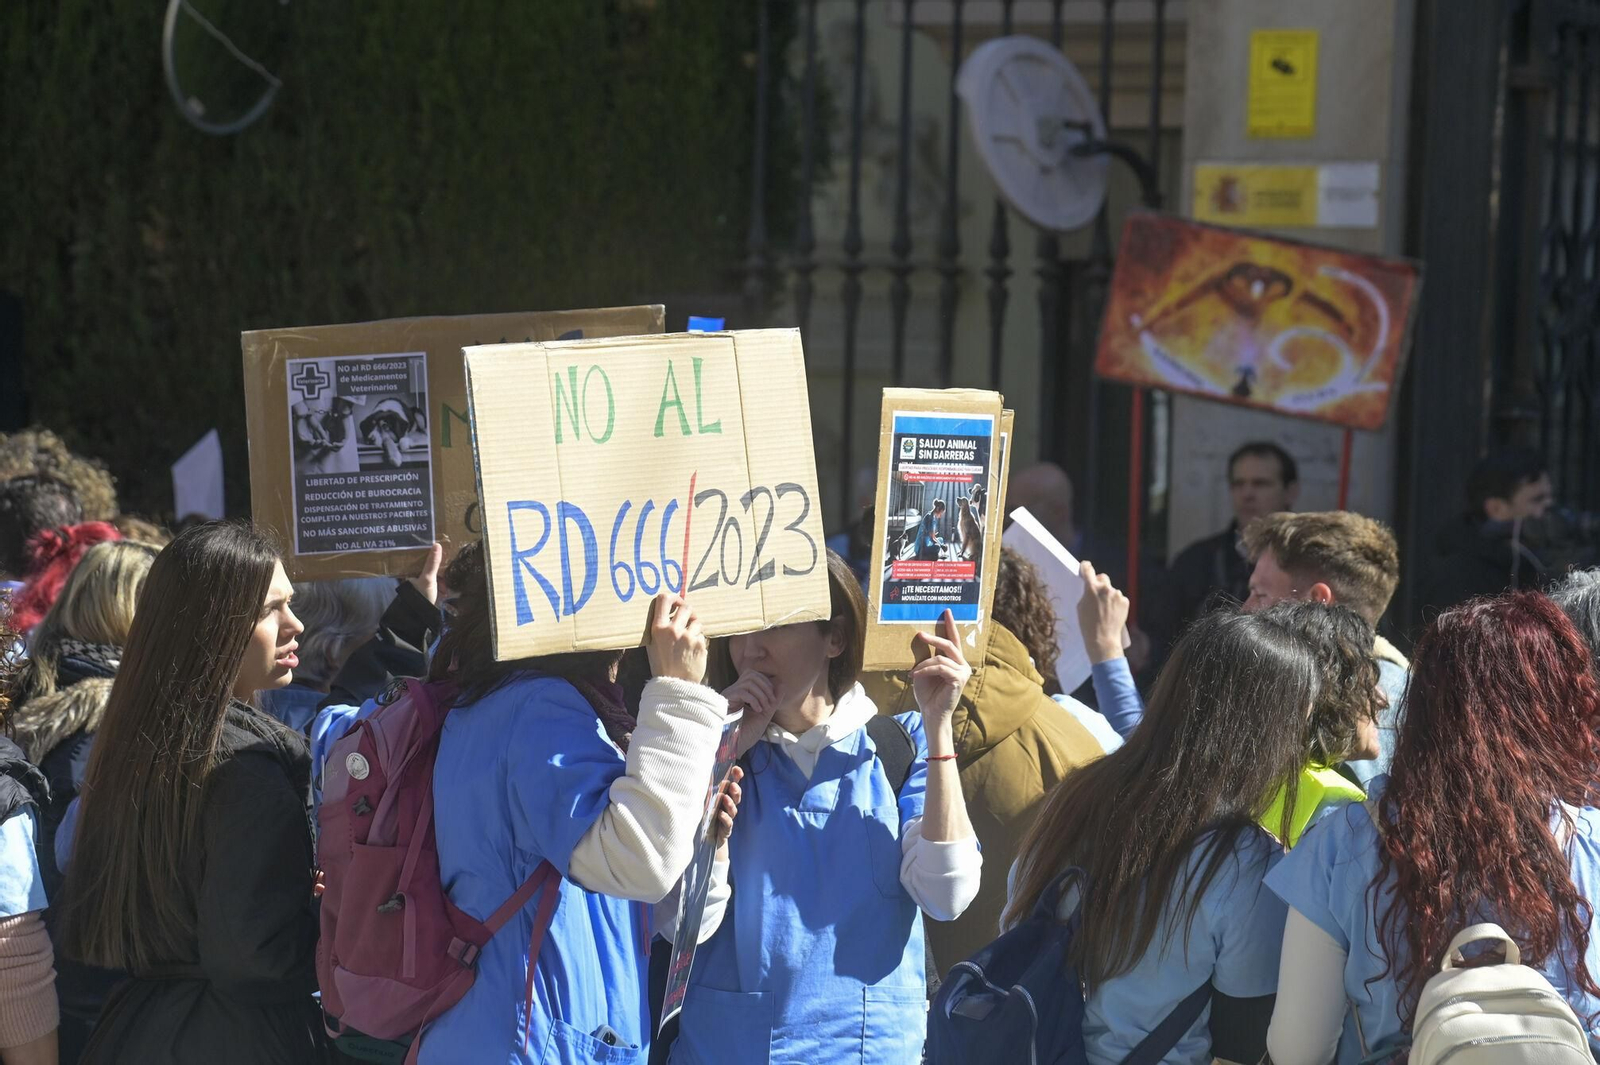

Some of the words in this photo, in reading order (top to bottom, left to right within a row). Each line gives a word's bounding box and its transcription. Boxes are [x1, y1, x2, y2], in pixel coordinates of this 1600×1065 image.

[338, 365, 350, 373] NO
[352, 364, 359, 372] al
[361, 363, 371, 371] RD
[373, 361, 407, 370] 666/2023
[340, 375, 350, 383] de
[351, 372, 408, 382] Medicamentos
[350, 383, 398, 393] Veterinarios
[555, 364, 615, 444] NO
[653, 356, 722, 438] AL
[919, 438, 946, 449] SALUD
[946, 439, 977, 450] ANIMAL
[918, 449, 932, 460] SIN
[933, 450, 975, 461] BARRERAS
[305, 477, 345, 487] LIBERTAD
[347, 476, 358, 484] DE
[360, 472, 419, 483] PRESCRIPCIÓN
[305, 490, 353, 501] REDUCCIÓN
[355, 490, 366, 498] DE
[368, 487, 421, 497] BUROCRACIA
[304, 503, 358, 513] DISPENSACIÓN
[371, 500, 423, 510] TRATAMIENTO
[301, 514, 341, 524] COMPLETO
[349, 512, 387, 521] NUESTROS
[389, 509, 428, 518] PACIENTES
[303, 529, 316, 537] NO
[318, 527, 336, 536] MÁS
[338, 525, 385, 536] SANCIONES
[386, 523, 427, 533] ABUSIVAS
[335, 542, 349, 550] NO
[350, 541, 361, 549] AL
[378, 539, 396, 547] 21%
[507, 500, 599, 627] RD
[609, 470, 818, 603] 666/2023
[902, 585, 914, 595] ¡¡TE
[915, 585, 962, 594] NECESITAMOS!!
